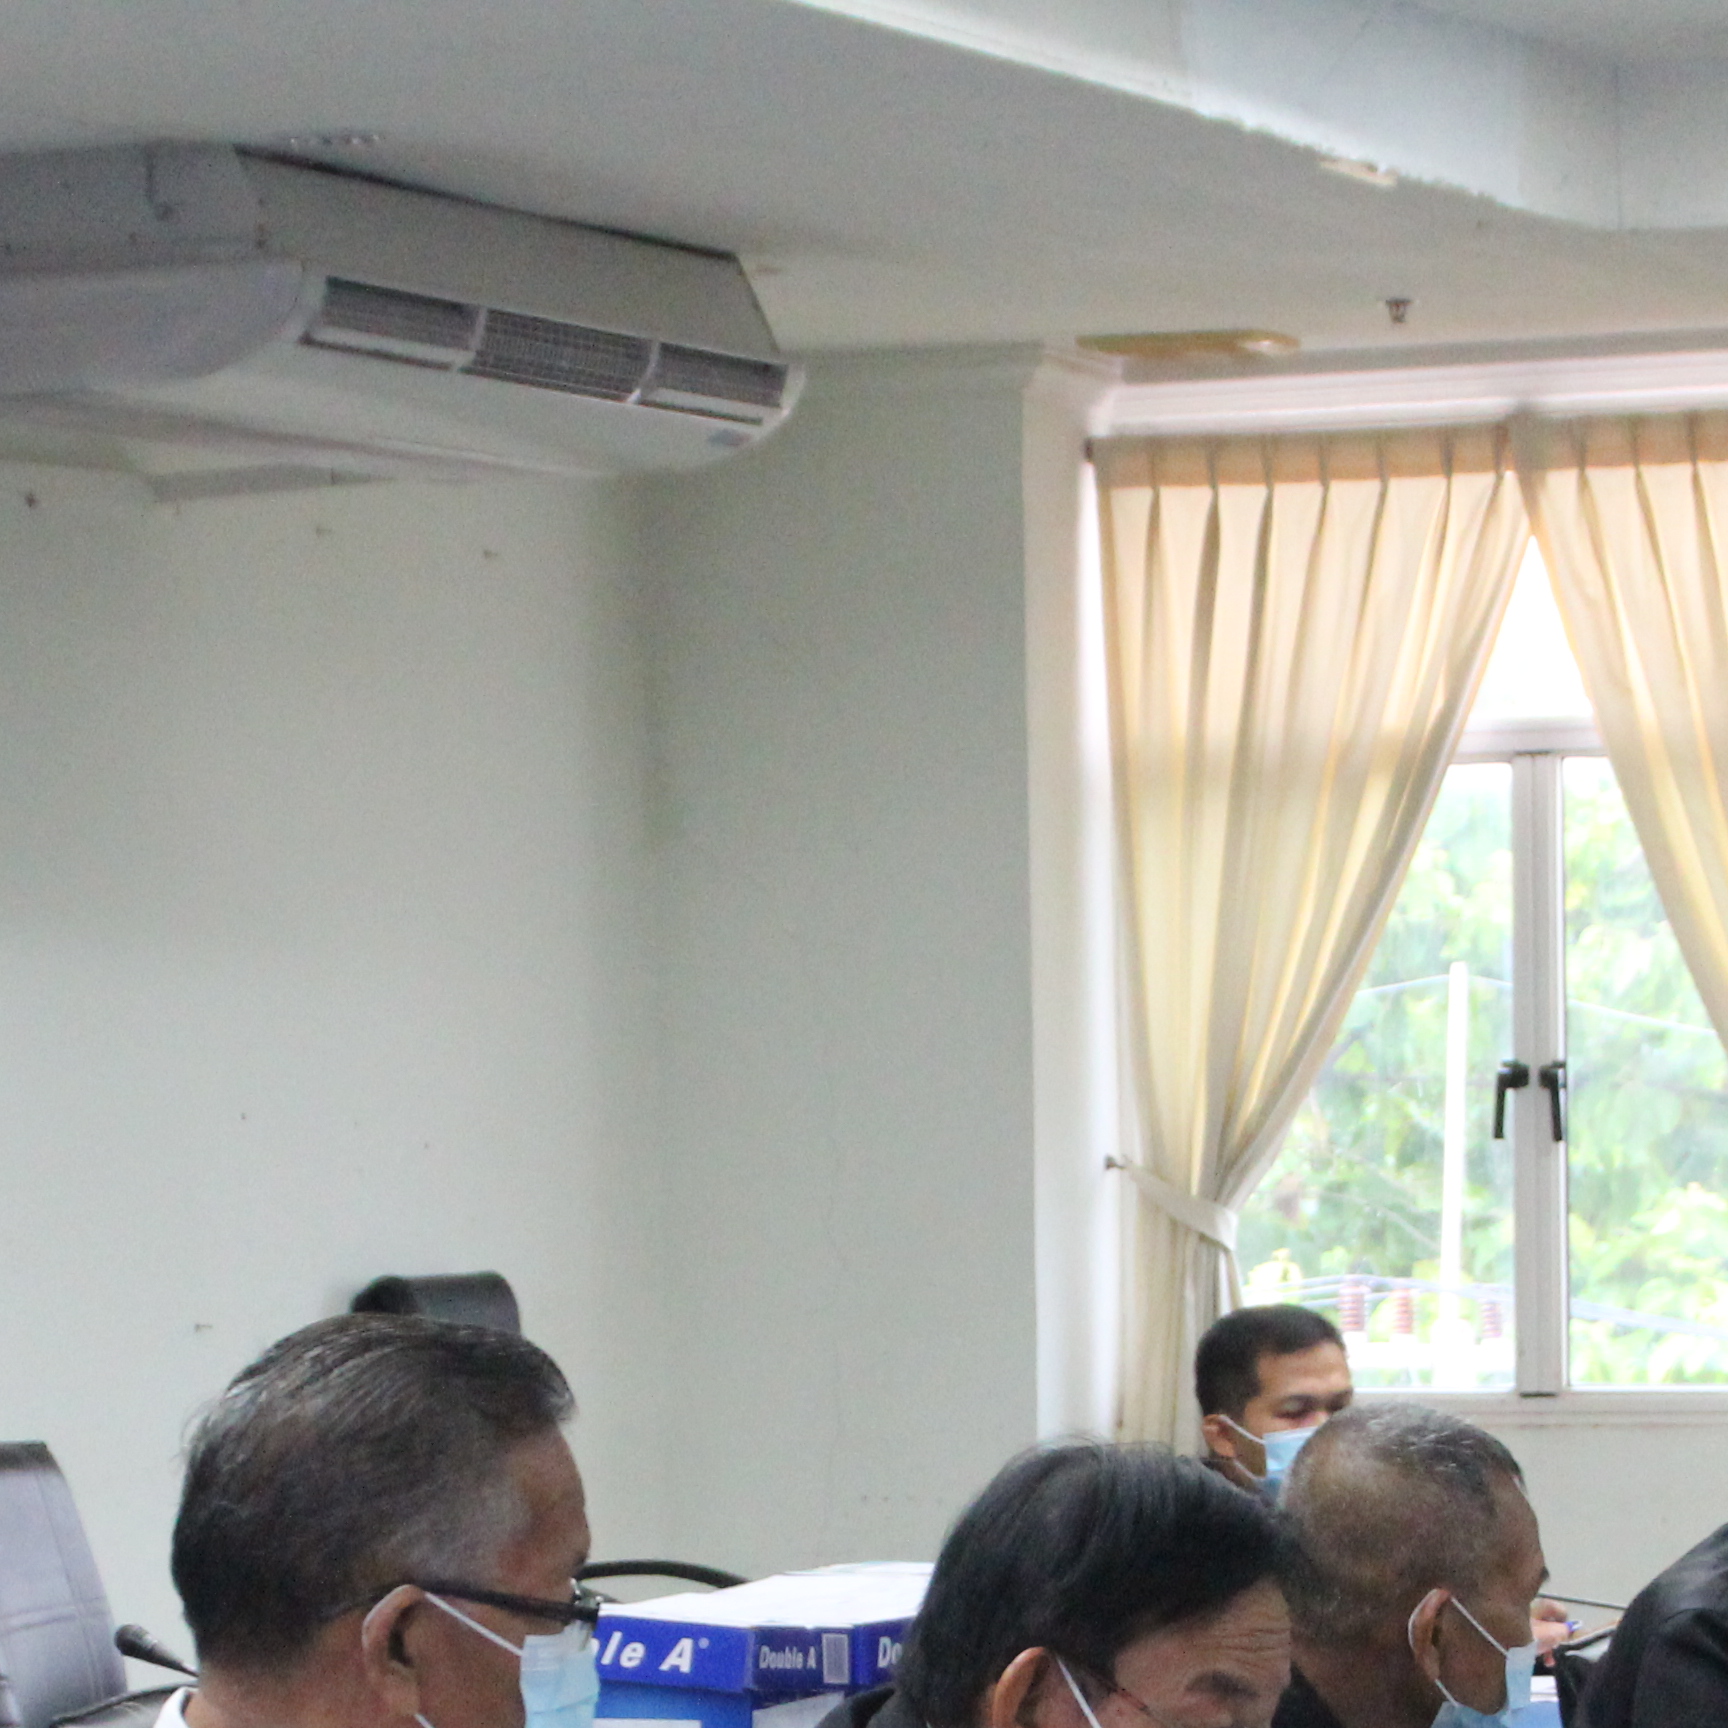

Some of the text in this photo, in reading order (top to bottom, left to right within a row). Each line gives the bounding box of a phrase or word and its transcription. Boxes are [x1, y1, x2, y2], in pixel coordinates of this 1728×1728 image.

[658, 1637, 694, 1674] A
[758, 1645, 817, 1670] Double A
